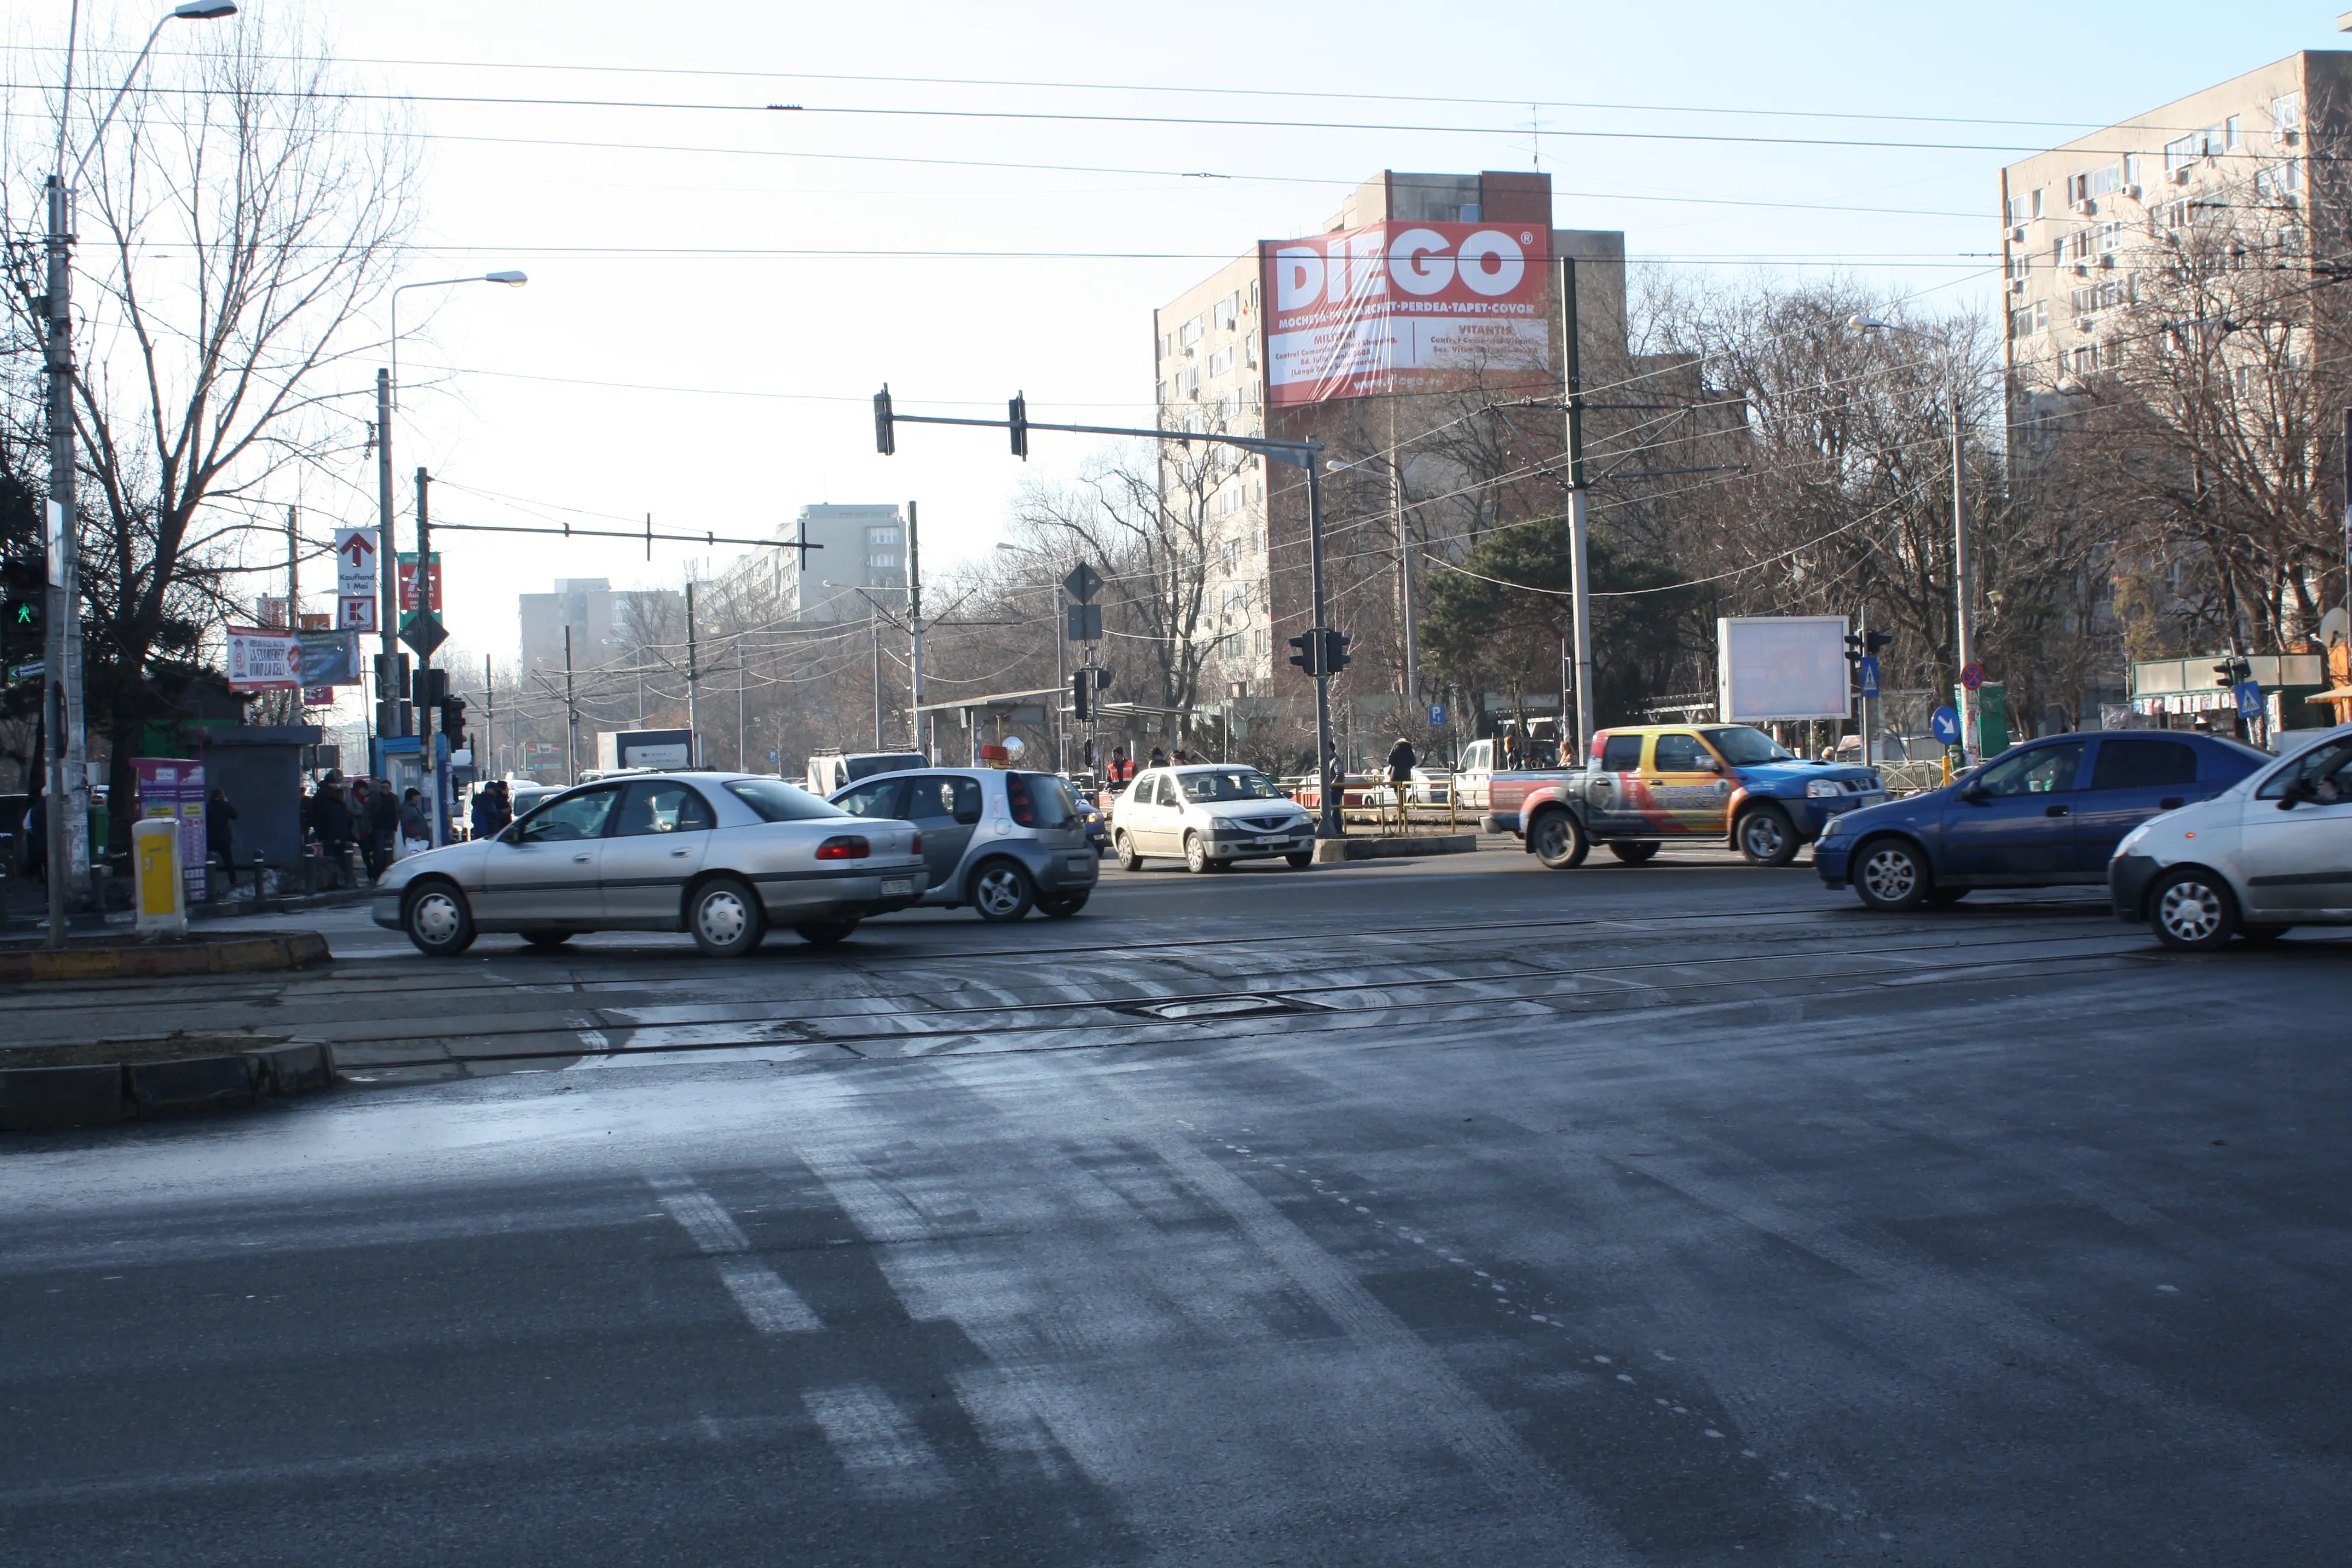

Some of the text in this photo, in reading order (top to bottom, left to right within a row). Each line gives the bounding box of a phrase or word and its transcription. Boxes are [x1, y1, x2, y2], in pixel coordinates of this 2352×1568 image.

[1276, 229, 1525, 312] DIEGO
[1400, 302, 1449, 312] PERDEA
[1452, 302, 1487, 313] TAPET
[1492, 304, 1534, 313] COVOR
[1459, 325, 1512, 335] VITANTIS
[1275, 350, 1299, 360] Centrul
[1432, 707, 1440, 719] P
